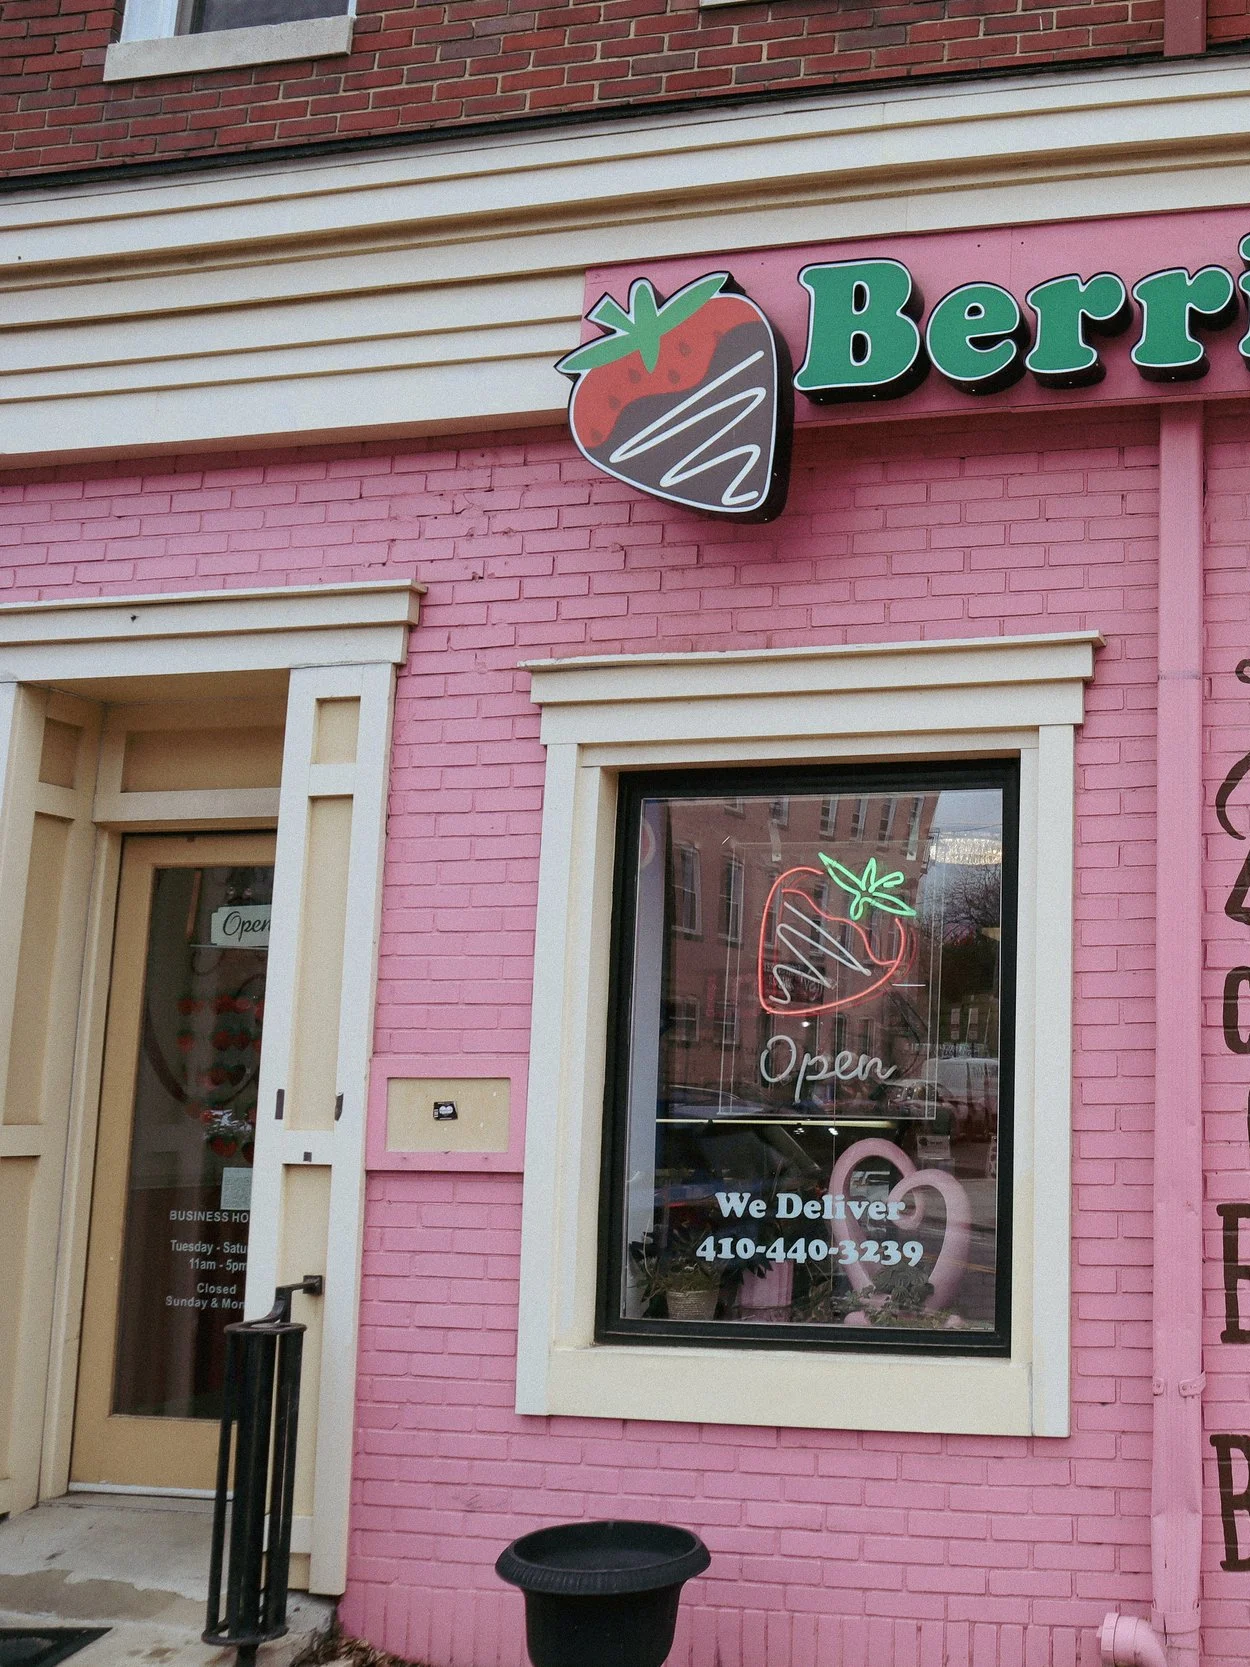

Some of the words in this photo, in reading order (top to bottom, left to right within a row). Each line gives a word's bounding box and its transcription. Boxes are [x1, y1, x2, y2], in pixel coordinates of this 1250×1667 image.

[223, 911, 271, 942] Open
[760, 1034, 898, 1104] Open
[714, 1192, 768, 1219] We
[776, 1192, 906, 1221] Deliver
[169, 1210, 229, 1222] BUSINESS
[231, 1212, 250, 1223] HO
[170, 1239, 214, 1254] Tuesday
[223, 1241, 249, 1254] Satu
[696, 1237, 924, 1267] 410-440-3239
[189, 1258, 216, 1270] 11am
[226, 1259, 248, 1273] 5pm
[197, 1283, 237, 1294] Closed
[165, 1296, 207, 1310] Sunday
[210, 1299, 219, 1308] &
[221, 1299, 246, 1309] Mon
